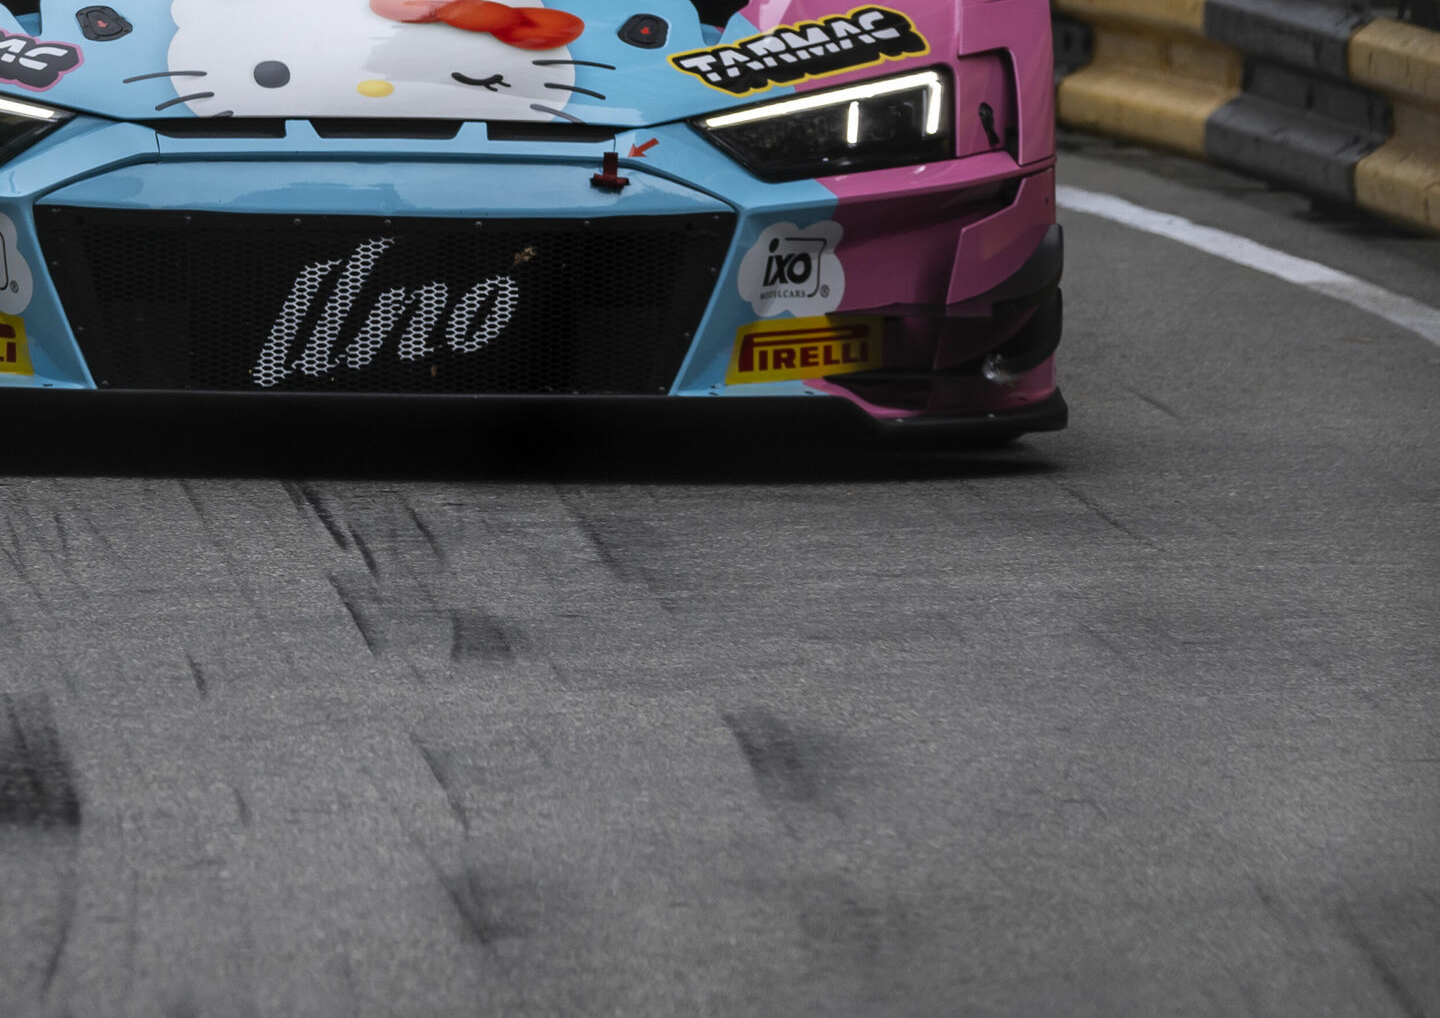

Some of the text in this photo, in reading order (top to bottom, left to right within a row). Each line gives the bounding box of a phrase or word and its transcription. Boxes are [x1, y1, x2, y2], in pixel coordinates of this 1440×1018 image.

[680, 11, 900, 82] TARMAC
[760, 289, 806, 300] LCARS
[738, 324, 870, 372] PIRELLI
